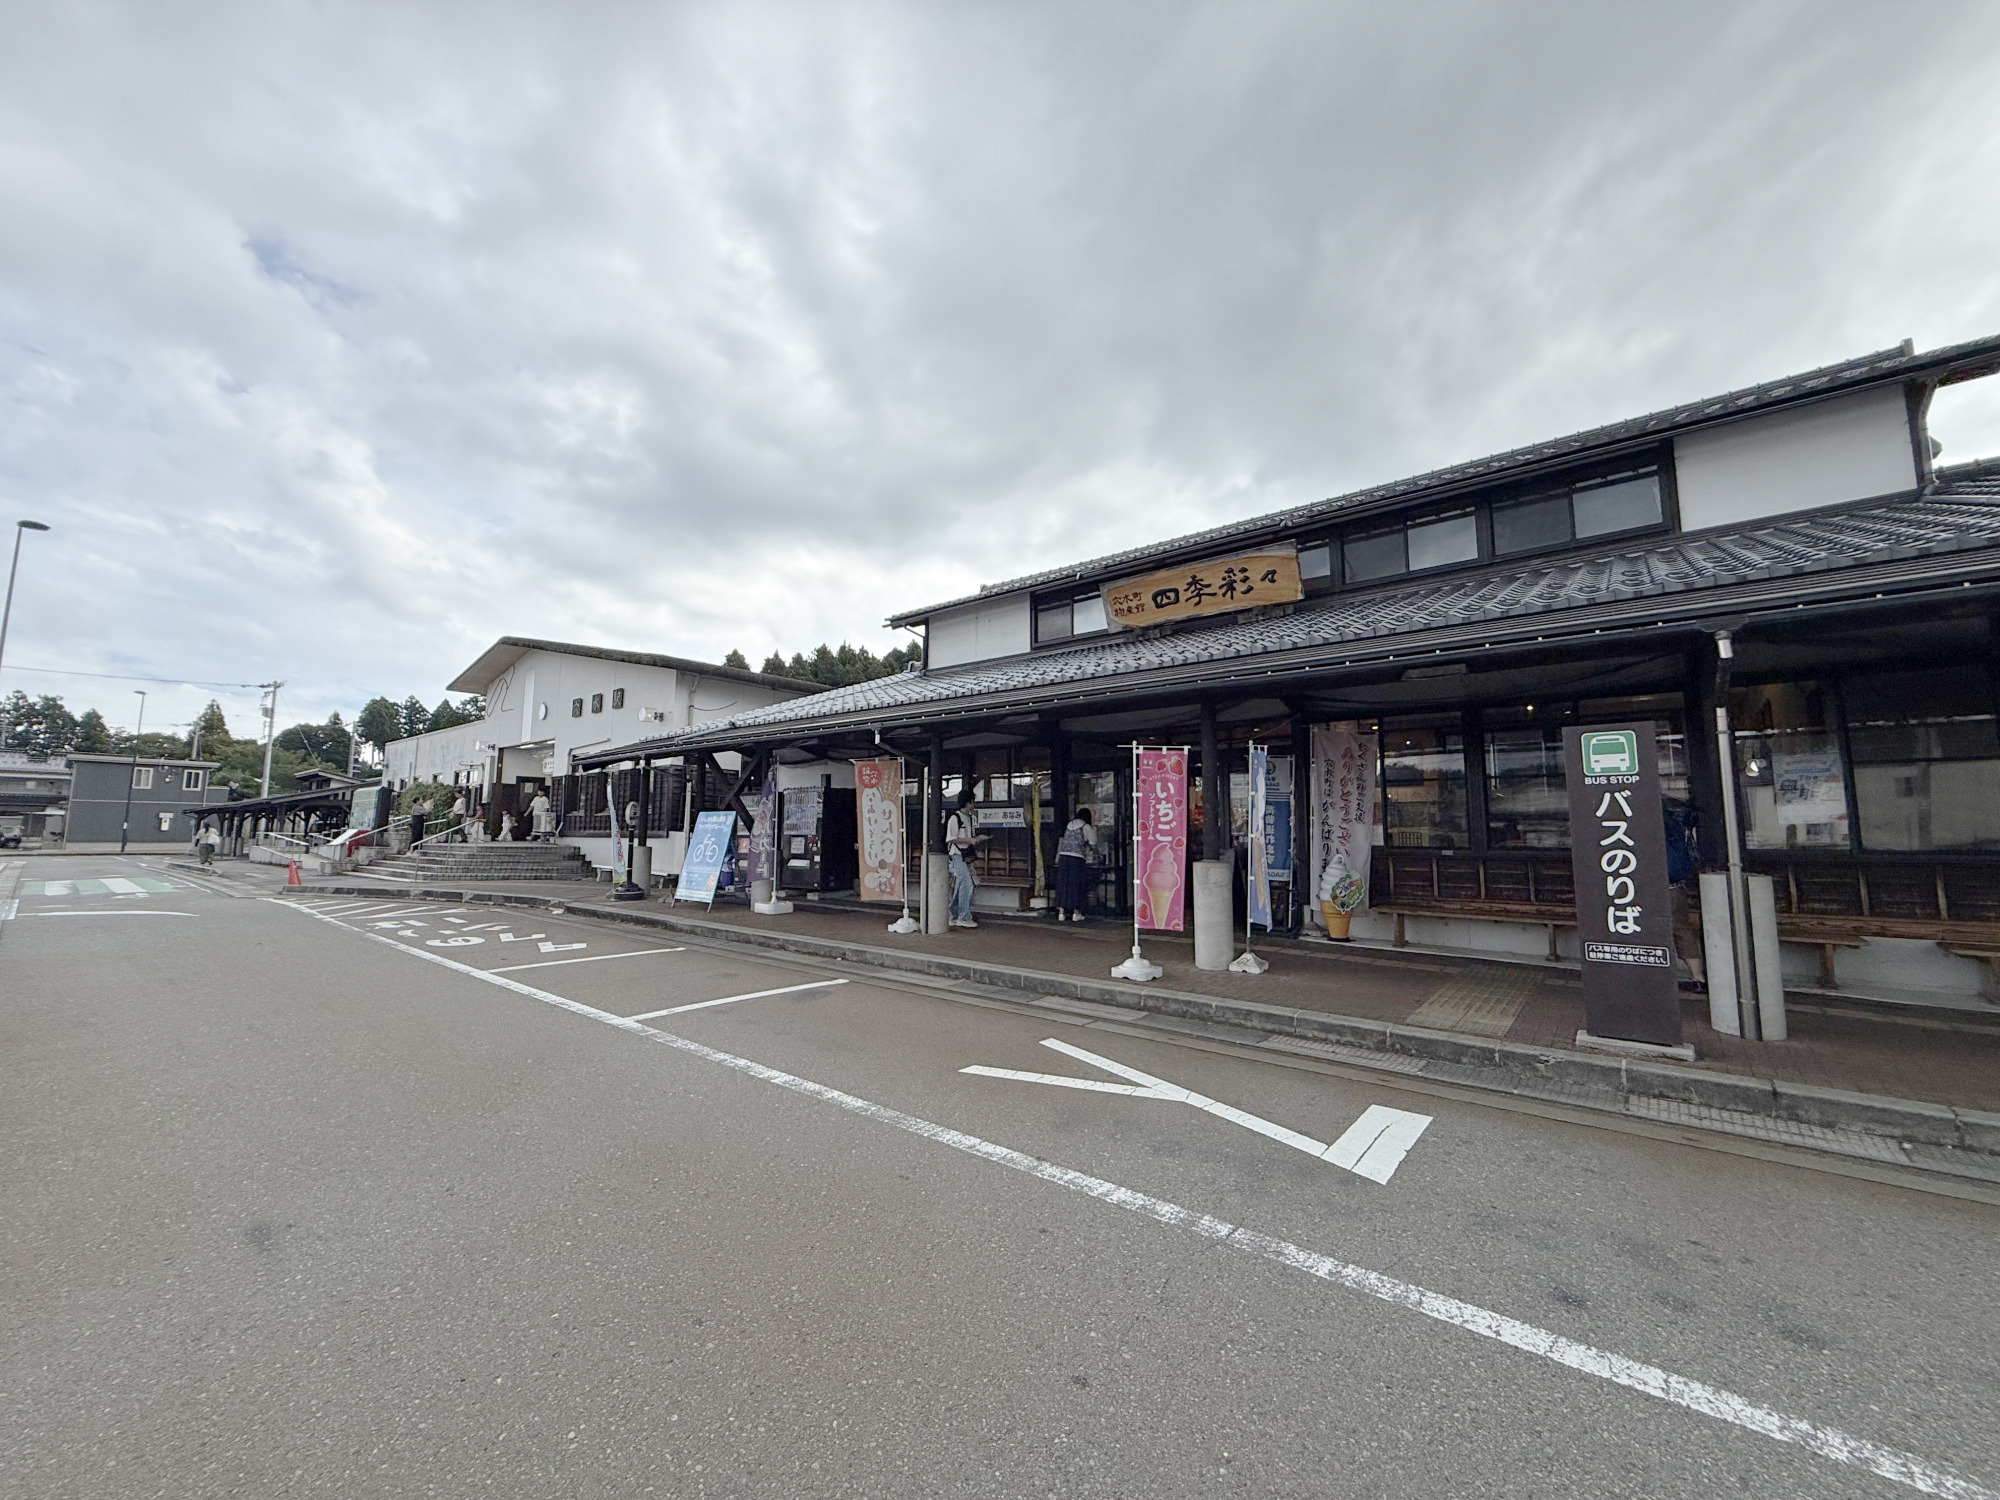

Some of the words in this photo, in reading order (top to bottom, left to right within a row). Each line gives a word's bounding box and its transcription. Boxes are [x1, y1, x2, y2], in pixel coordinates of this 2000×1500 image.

[1112, 591, 1143, 606] 穴水町
[1152, 566, 1277, 609] 四季彩々
[1114, 603, 1145, 617] 物産館
[1584, 777, 1608, 785] BUS
[1610, 775, 1639, 784] STOP
[1001, 811, 1025, 820] あなみ
[1155, 781, 1176, 842] いちご
[1321, 758, 1335, 871] 穴水町はがんばりま
[1336, 747, 1354, 858] ありがとうござい
[1595, 789, 1643, 935] バスのりば
[1588, 945, 1663, 957] バス専用のりばにつき
